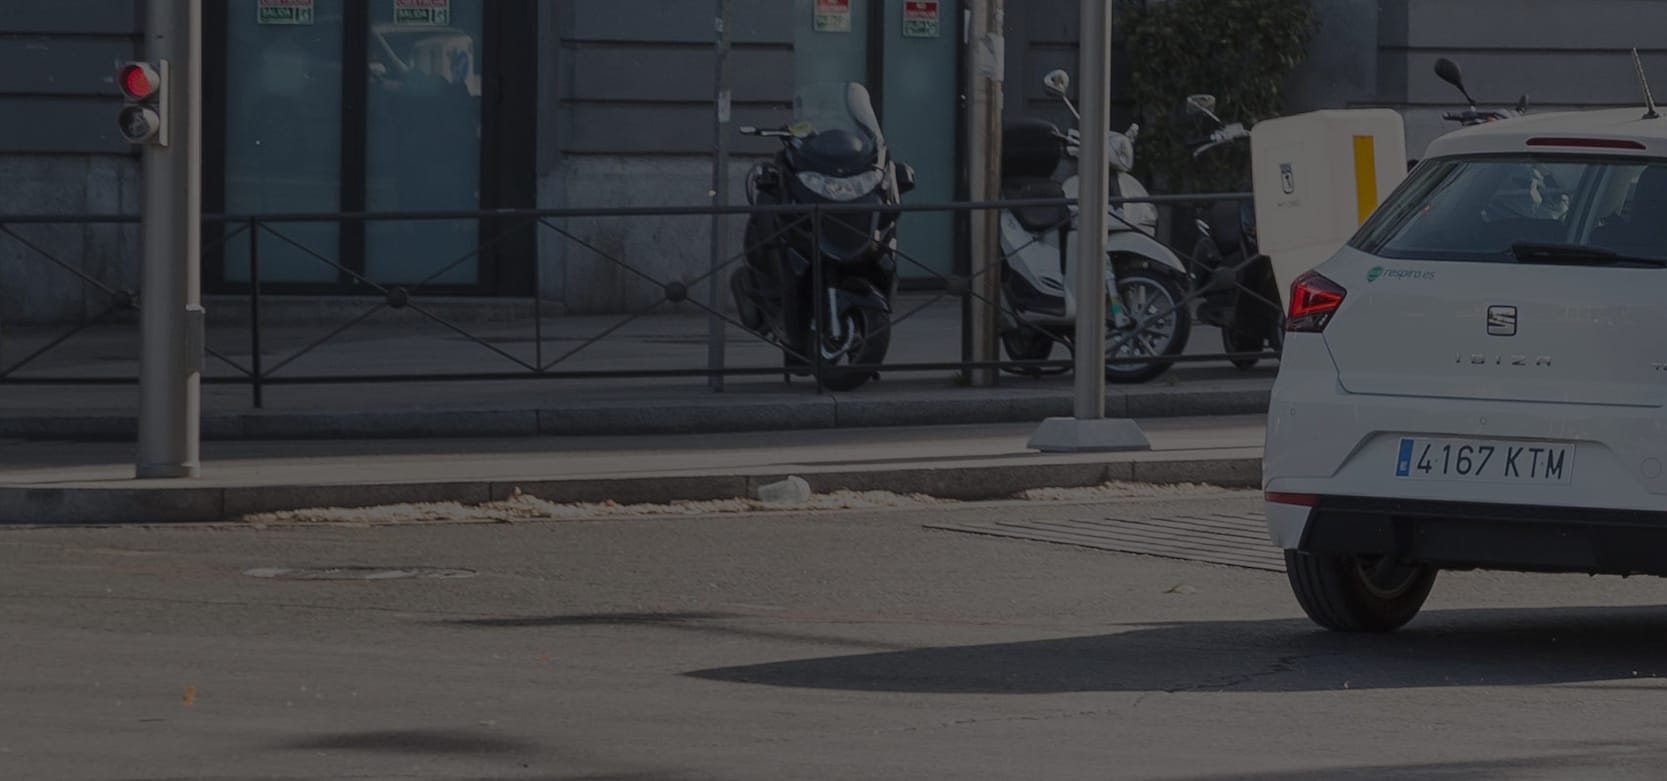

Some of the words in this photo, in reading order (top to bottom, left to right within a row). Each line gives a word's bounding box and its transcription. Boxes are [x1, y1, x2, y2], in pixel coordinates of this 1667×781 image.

[1456, 352, 1551, 366] IBIZA
[1417, 443, 1495, 476] 4167
[1504, 447, 1565, 480] KTM
